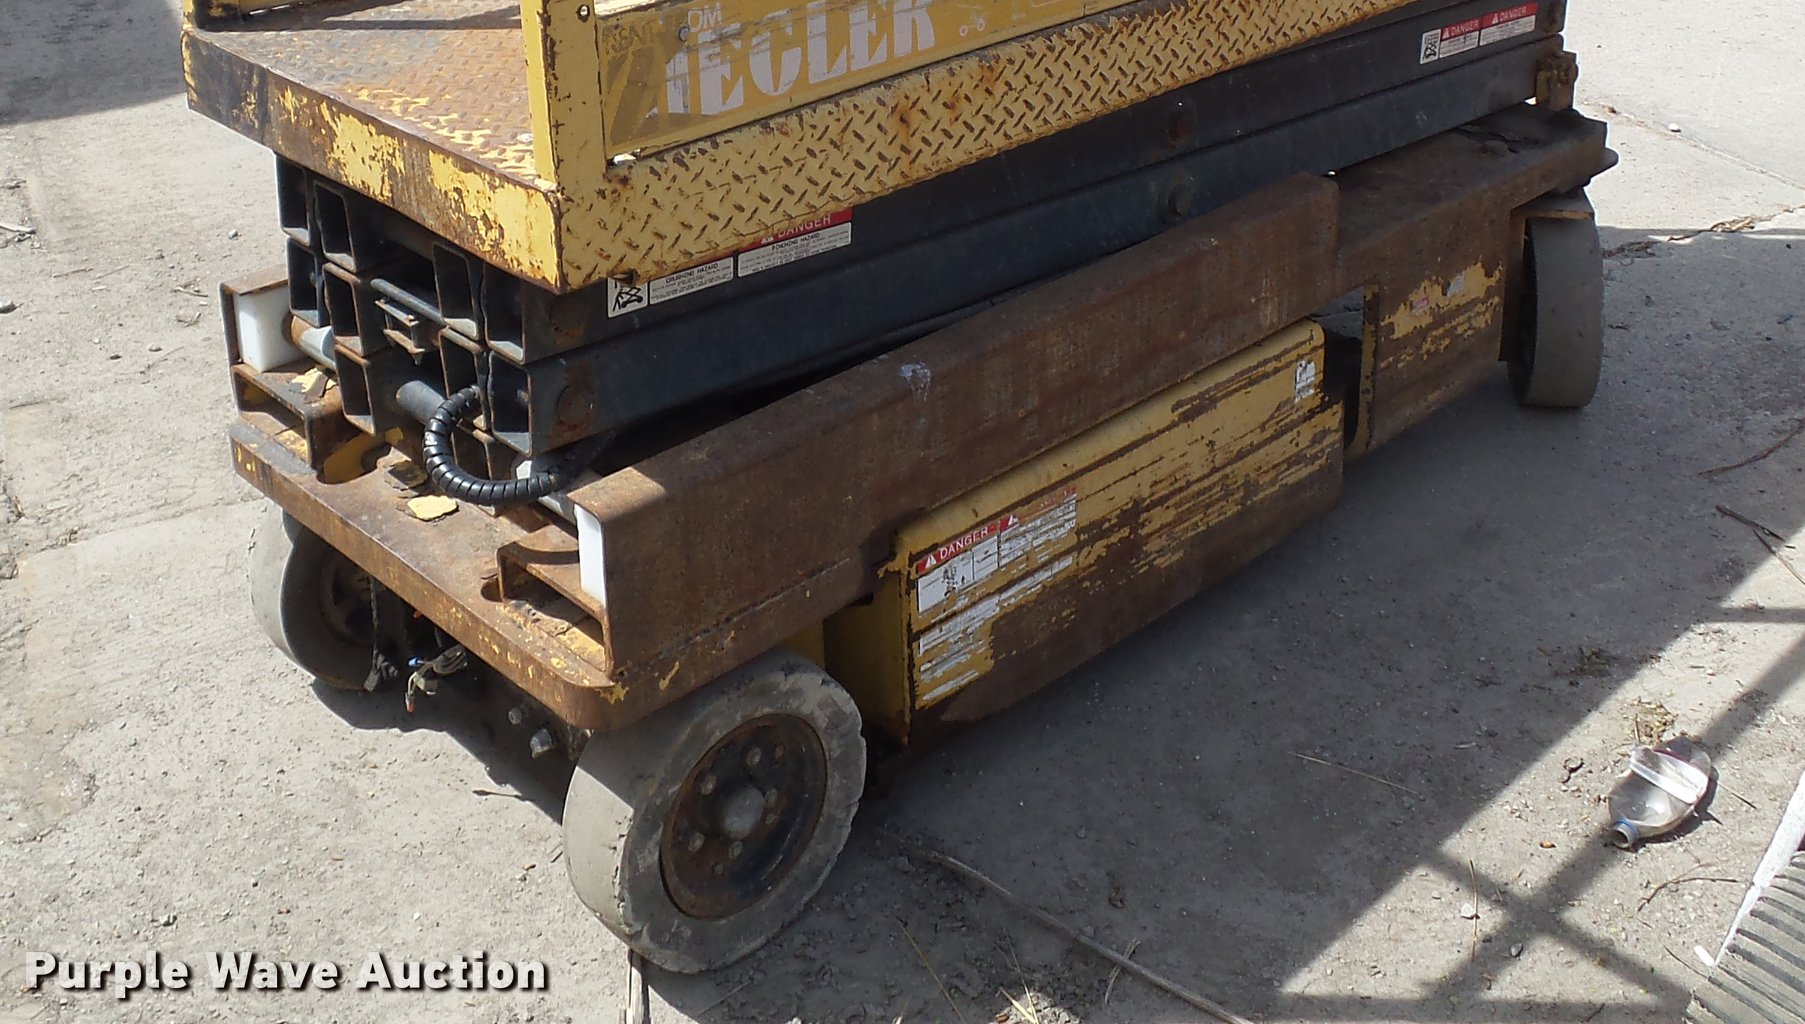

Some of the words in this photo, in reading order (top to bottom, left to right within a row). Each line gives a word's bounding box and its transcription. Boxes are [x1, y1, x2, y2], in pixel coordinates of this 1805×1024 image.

[1500, 7, 1527, 22] DANGER
[1451, 20, 1479, 36] DANGER
[940, 527, 989, 560] DANGER
